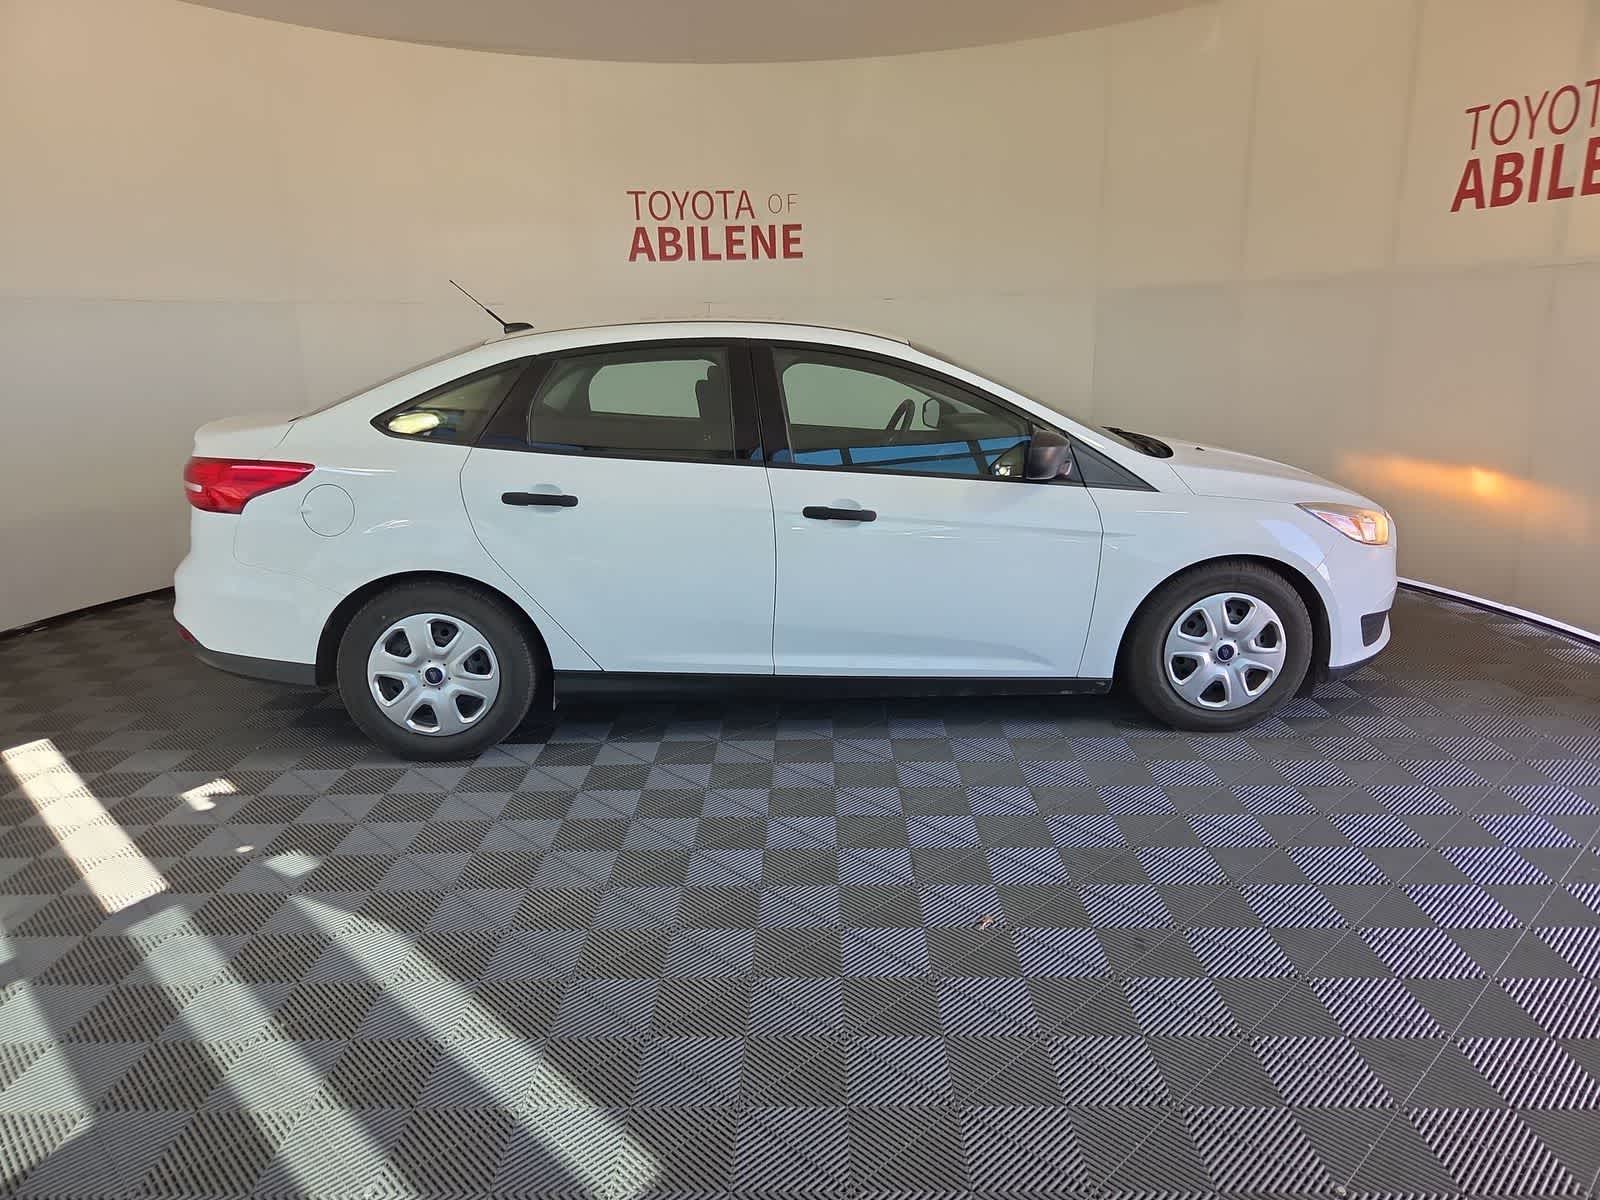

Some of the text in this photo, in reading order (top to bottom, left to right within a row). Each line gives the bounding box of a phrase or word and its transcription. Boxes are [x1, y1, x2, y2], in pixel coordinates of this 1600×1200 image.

[1450, 136, 1600, 212] ABILE
[626, 190, 799, 220] TOYOTA OF
[628, 223, 804, 262] ABILENE
